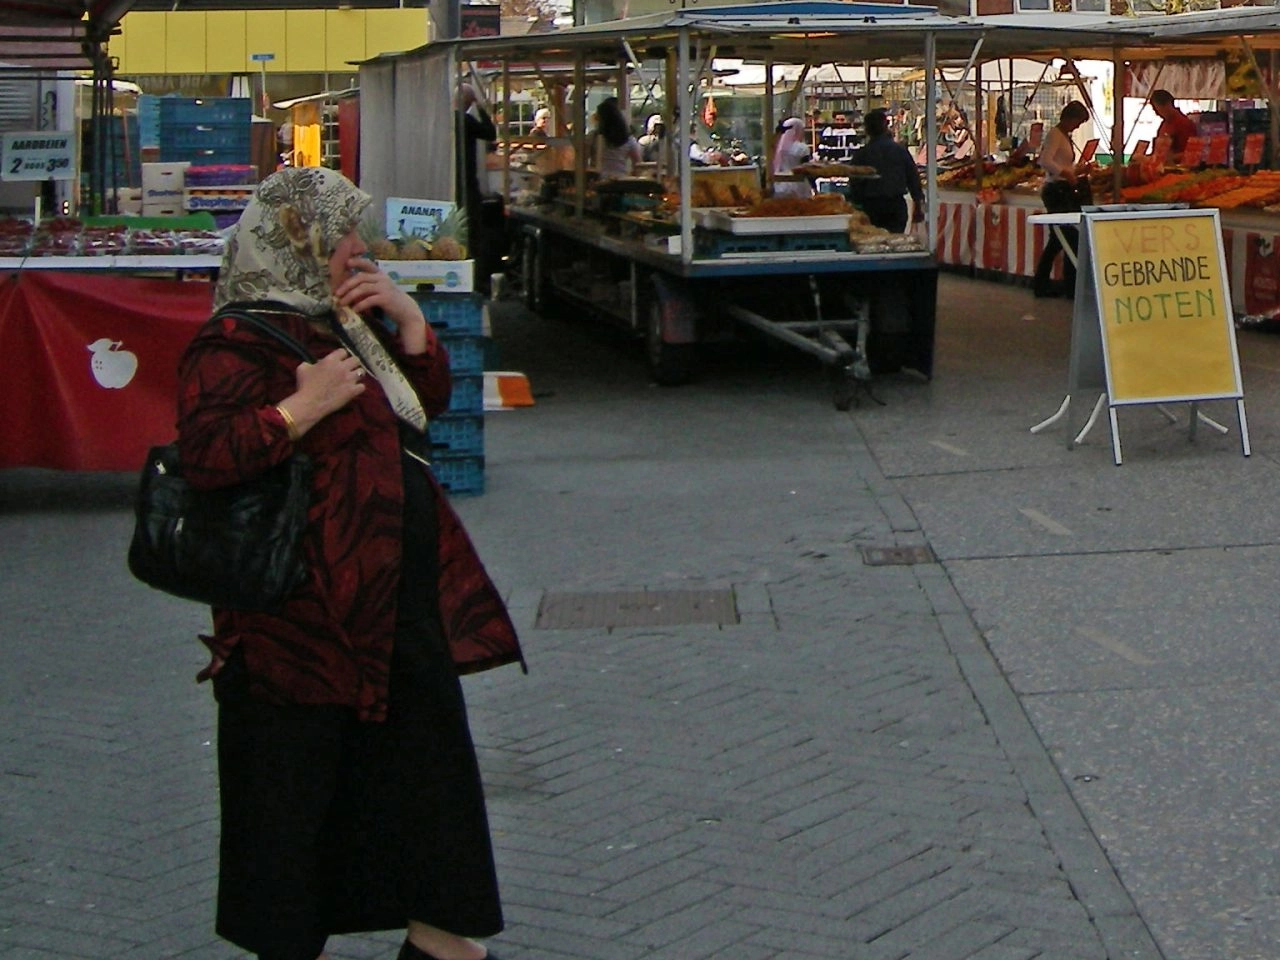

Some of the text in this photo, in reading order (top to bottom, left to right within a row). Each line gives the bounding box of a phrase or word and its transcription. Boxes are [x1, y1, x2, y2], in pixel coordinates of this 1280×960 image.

[10, 158, 23, 173] 2
[1113, 224, 1200, 253] VERS
[1104, 256, 1210, 287] GEBRANDE
[1115, 289, 1216, 324] NOTEN
